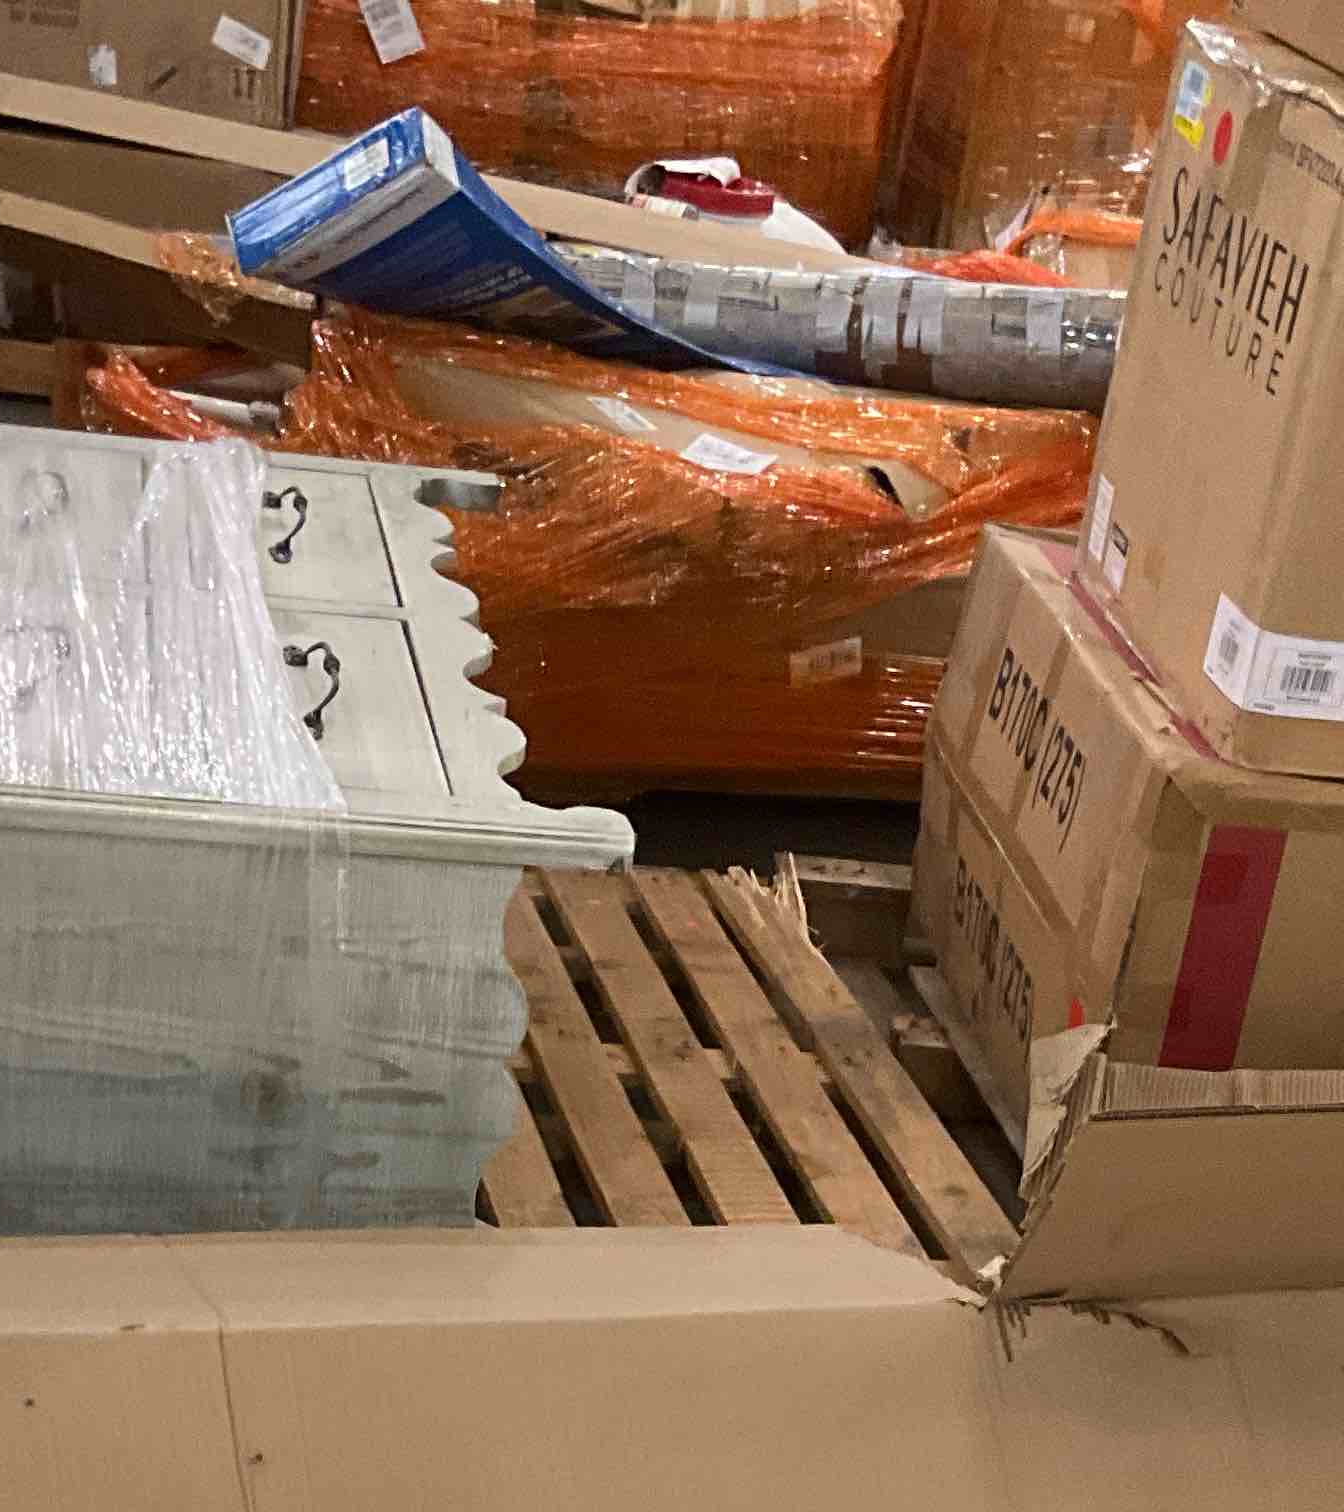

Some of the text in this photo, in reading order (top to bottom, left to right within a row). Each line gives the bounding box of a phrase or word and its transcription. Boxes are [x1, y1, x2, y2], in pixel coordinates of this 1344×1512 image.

[1154, 251, 1284, 396] COUTURE
[1163, 166, 1310, 345] SAFAVIEH
[987, 646, 1087, 855] B170C (275)
